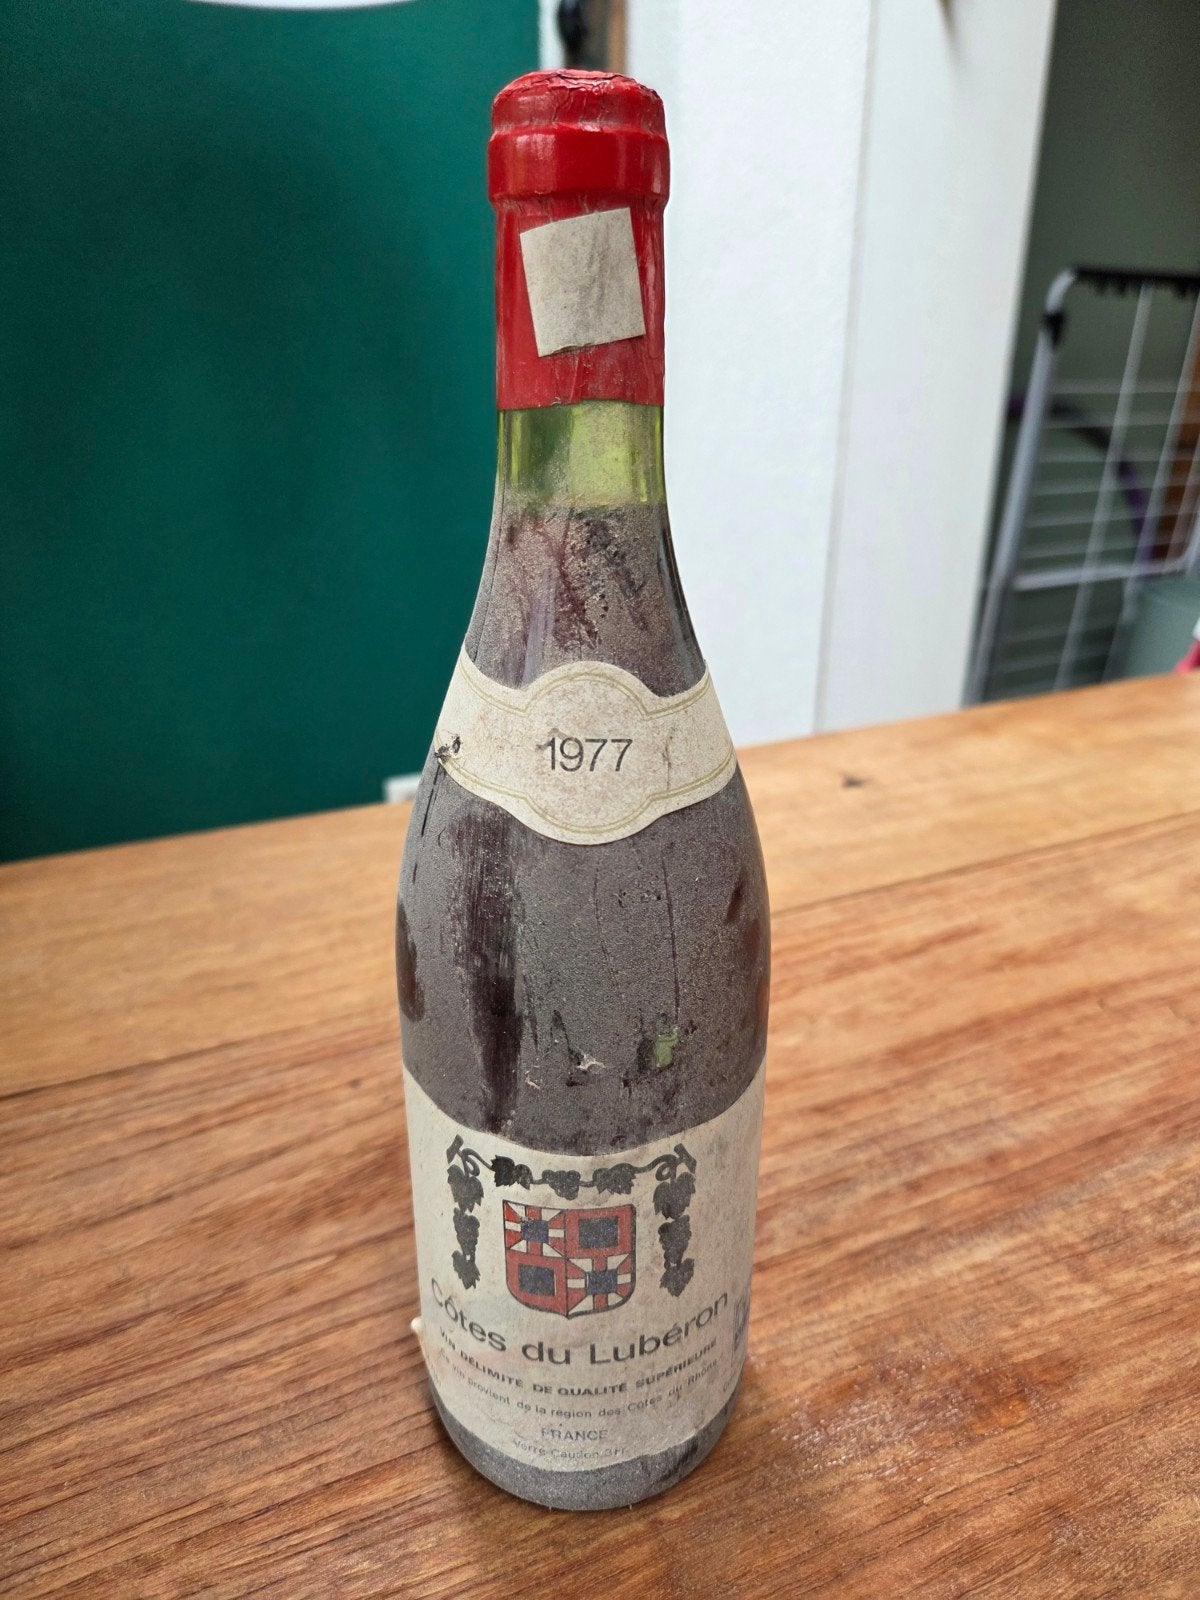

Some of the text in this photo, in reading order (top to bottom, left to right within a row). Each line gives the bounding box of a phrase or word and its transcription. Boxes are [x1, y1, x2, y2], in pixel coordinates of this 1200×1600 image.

[546, 738, 633, 772] 1977
[431, 1278, 507, 1352] Côtes
[521, 1341, 571, 1365] du
[589, 1292, 728, 1365] Lubéron
[440, 1326, 456, 1350] VIN
[532, 1383, 553, 1395] DE
[467, 1379, 511, 1406] provient
[516, 1401, 532, 1412] de
[535, 1406, 546, 1415] la
[598, 1407, 621, 1417] des
[668, 1384, 683, 1397] du
[541, 1427, 610, 1441] FRANCE
